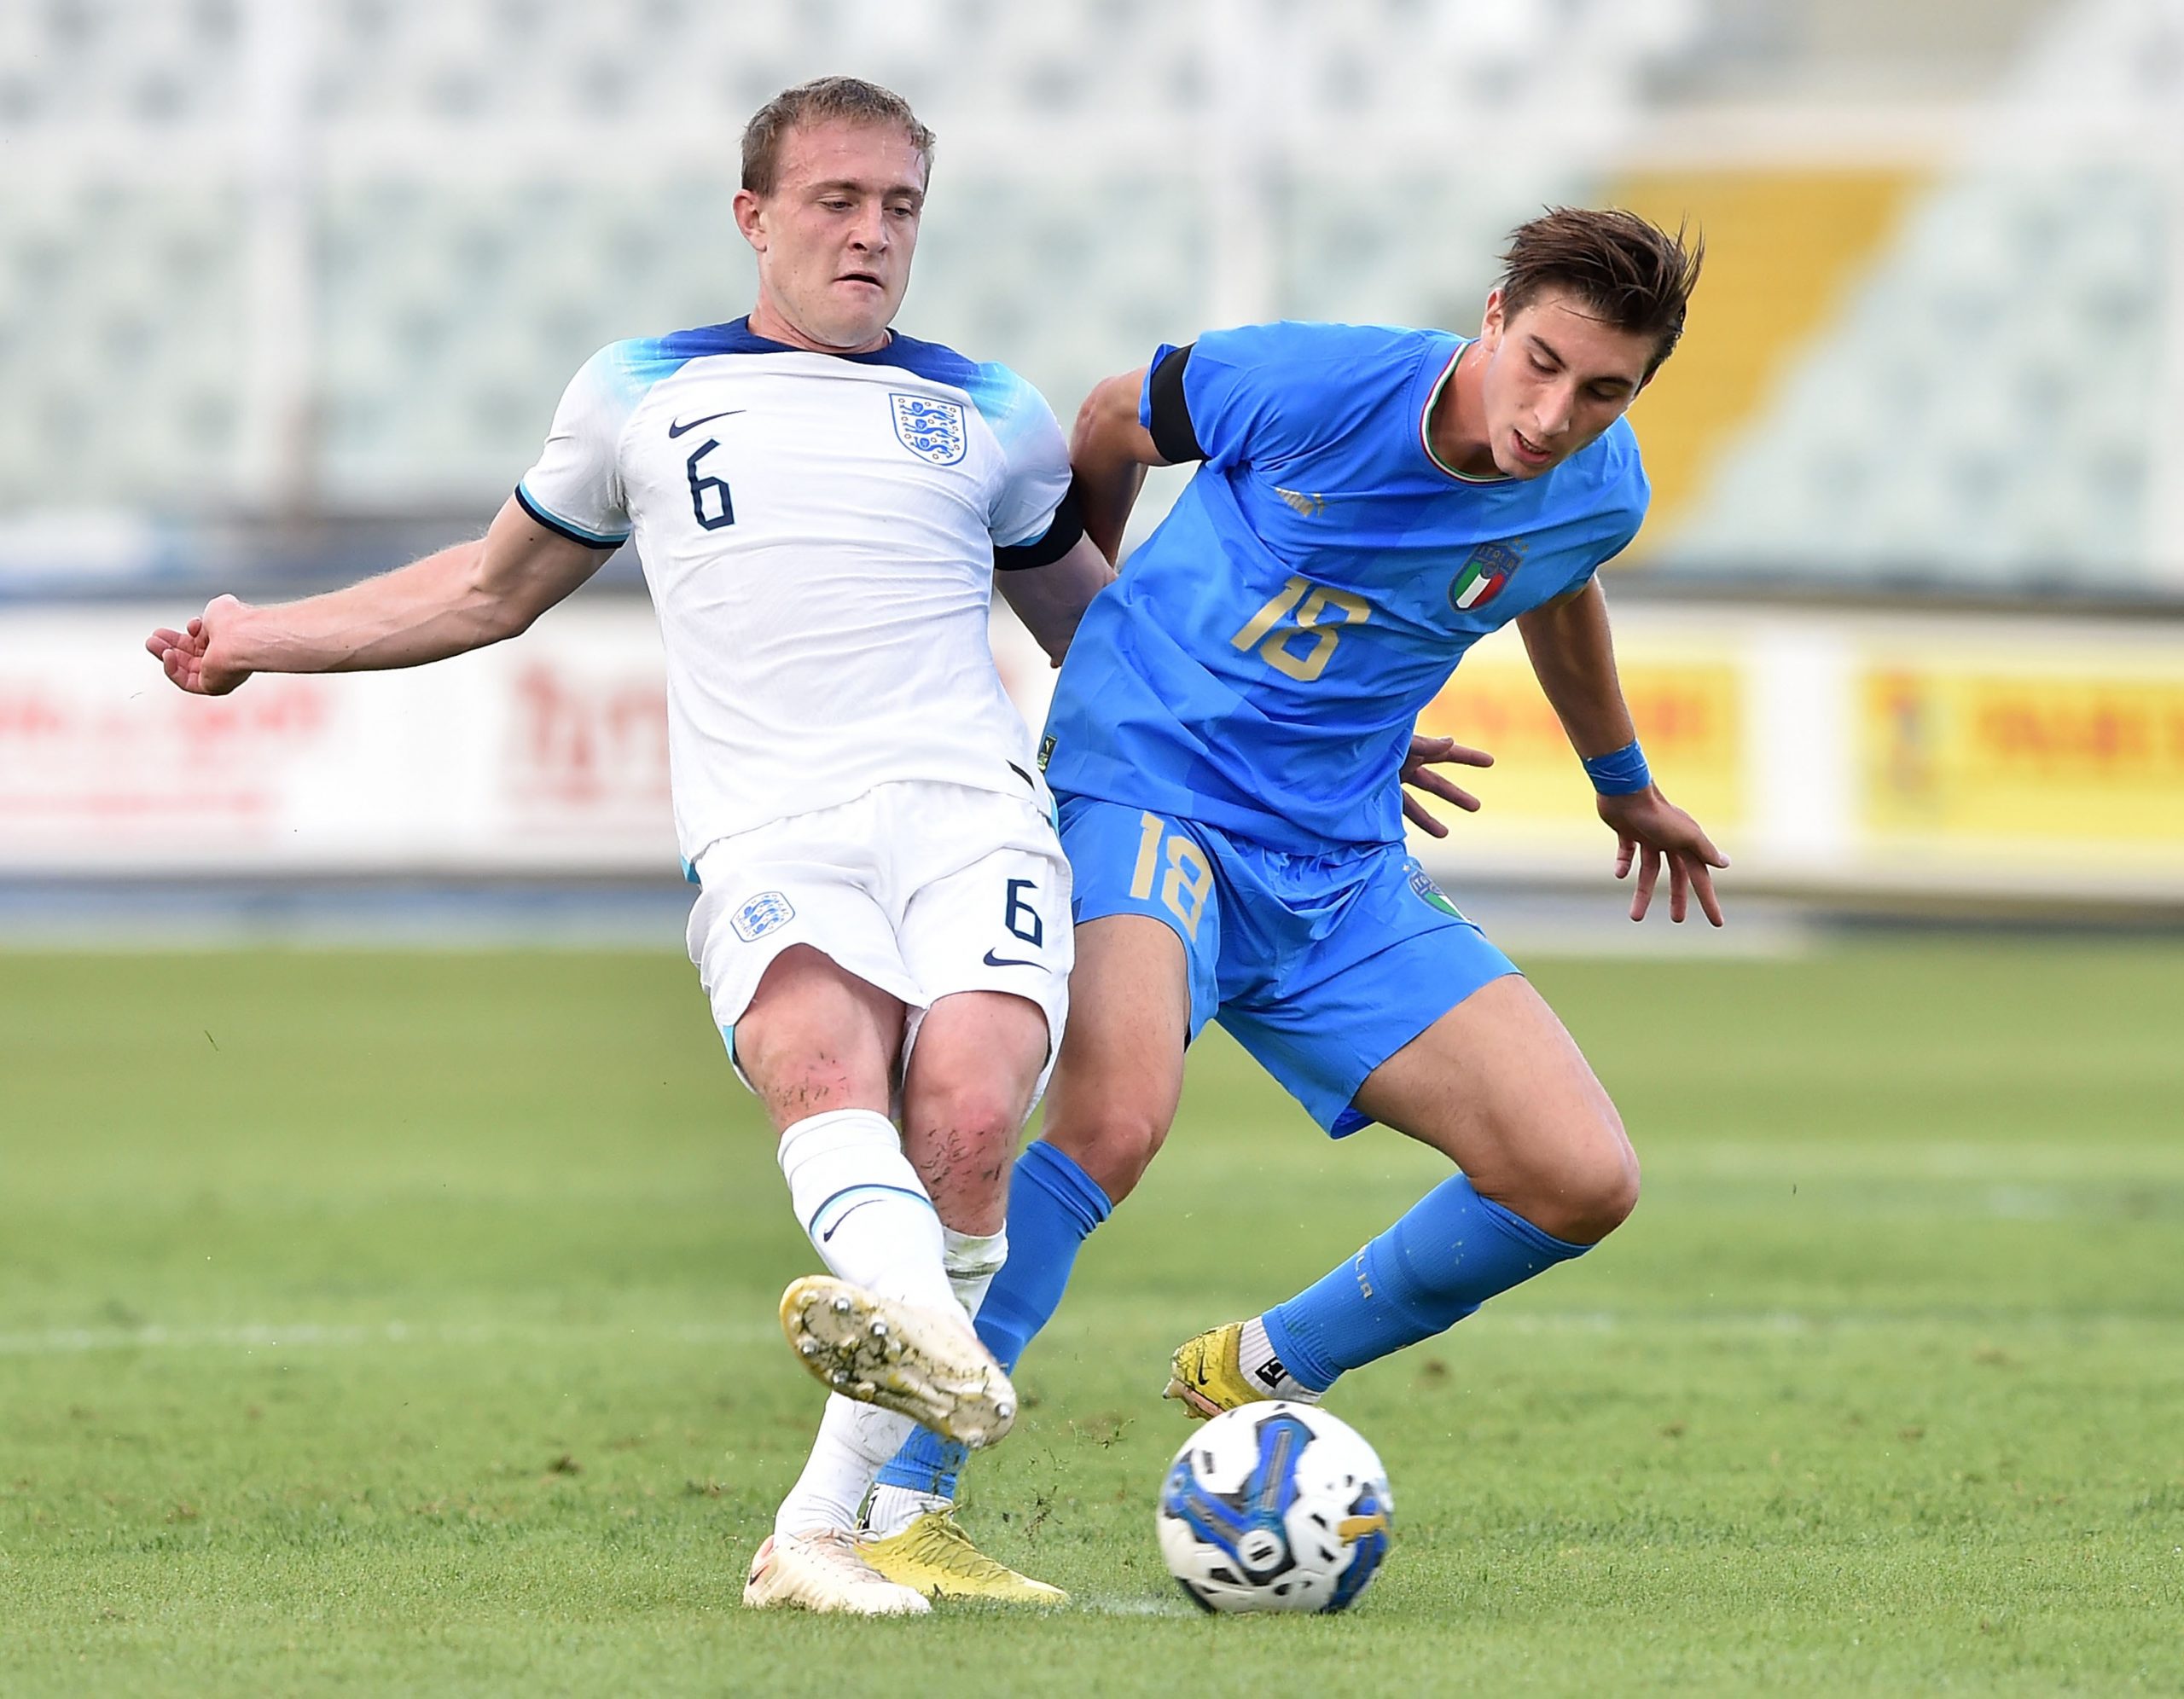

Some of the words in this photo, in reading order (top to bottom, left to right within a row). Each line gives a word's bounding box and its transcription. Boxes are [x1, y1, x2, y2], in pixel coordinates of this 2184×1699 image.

[687, 438, 735, 531] 6
[1230, 576, 1371, 681] 18
[1005, 878, 1043, 949] 6
[1130, 811, 1214, 943] 18
